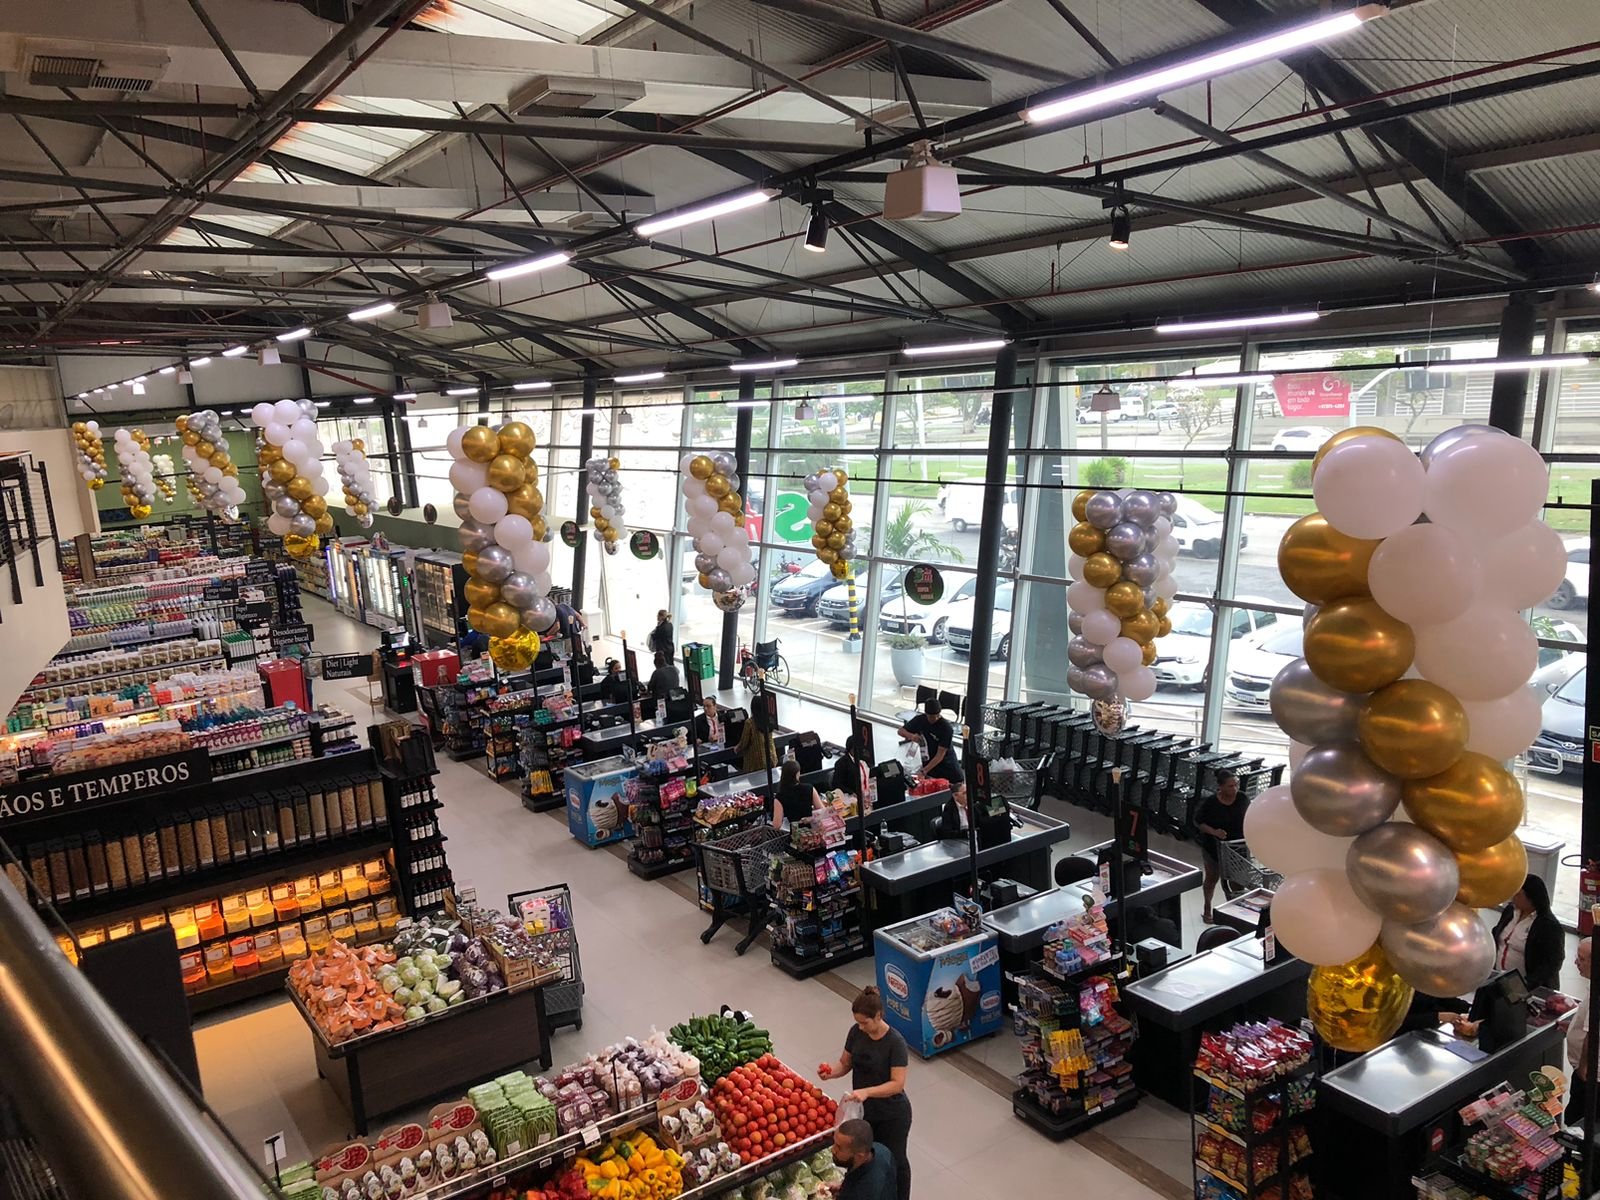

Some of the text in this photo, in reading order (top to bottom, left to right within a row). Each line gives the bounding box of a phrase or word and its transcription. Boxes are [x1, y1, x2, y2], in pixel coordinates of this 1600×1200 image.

[272, 626, 308, 636] Desodorantes
[273, 634, 310, 646] Higiene bucal
[325, 659, 339, 668] Diet
[343, 657, 359, 668] Light
[326, 669, 352, 678] Naturais
[976, 762, 985, 786] 8
[49, 787, 65, 808] E
[68, 762, 190, 803] TEMPEROS
[1129, 810, 1140, 836] 7
